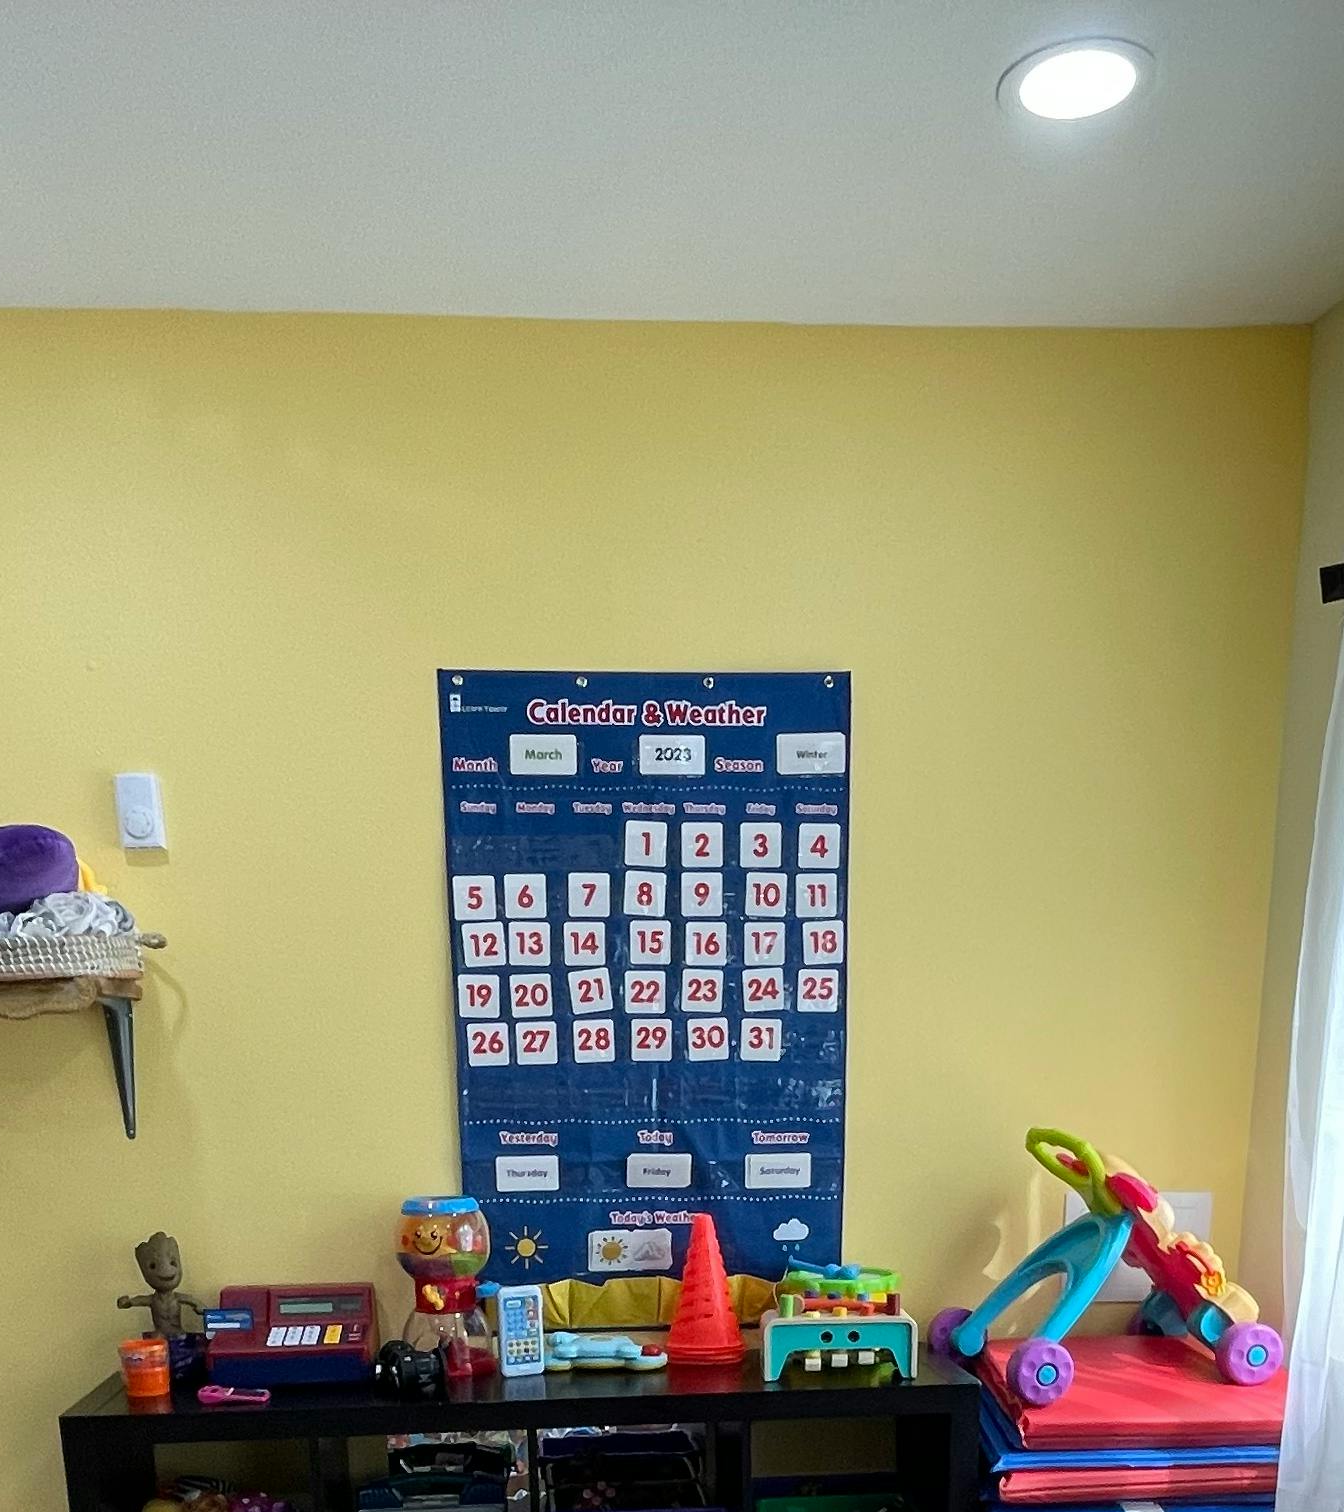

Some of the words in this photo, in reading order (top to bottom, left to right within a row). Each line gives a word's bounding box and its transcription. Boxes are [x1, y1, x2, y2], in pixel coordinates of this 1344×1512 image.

[527, 699, 637, 725] Calendar
[642, 701, 663, 726] &
[665, 700, 767, 726] Weather
[453, 757, 498, 772] Month
[525, 749, 562, 760] March
[591, 758, 623, 772] Year
[655, 748, 692, 761] 2023
[714, 757, 764, 773] Season
[796, 750, 828, 759] Winter
[460, 801, 496, 814] Sunday
[516, 801, 555, 815] Monday
[573, 801, 613, 815] Tuesday
[622, 801, 675, 815] Wednesday
[683, 802, 726, 815] Thursday
[746, 802, 776, 816] Friday
[796, 802, 838, 816] Saturday
[644, 832, 651, 854] 1
[695, 834, 710, 857] 2
[755, 833, 768, 858] 3
[811, 835, 828, 856] 4
[468, 885, 483, 910] 5
[517, 886, 533, 908] 6
[584, 883, 596, 904] 7
[637, 882, 653, 905] 8
[695, 882, 710, 904] 9
[754, 883, 781, 907] 10
[808, 884, 827, 905] 11
[471, 933, 497, 957] 12
[517, 930, 544, 955] 13
[571, 931, 598, 953] 14
[639, 930, 663, 954] 15
[695, 933, 720, 956] 16
[752, 931, 776, 951] 17
[811, 931, 837, 953] 18
[467, 984, 492, 1006] 19
[515, 984, 548, 1007] 20
[577, 979, 604, 1003] 21
[632, 980, 660, 1004] 22
[688, 978, 717, 1002] 23
[748, 978, 779, 1002] 24
[804, 977, 832, 1000] 25
[473, 1031, 504, 1056] 26
[523, 1029, 550, 1054] 27
[579, 1028, 611, 1052] 28
[637, 1026, 667, 1049] 29
[692, 1024, 725, 1050] 30
[750, 1027, 773, 1049] 31
[500, 1131, 558, 1146] Yesterday
[637, 1130, 673, 1145] Today
[752, 1131, 809, 1144] Tomorrow
[643, 1166, 671, 1177] Friday
[759, 1166, 800, 1176] Saturday
[609, 1210, 653, 1226] Today's
[654, 1210, 696, 1224] Weathe
